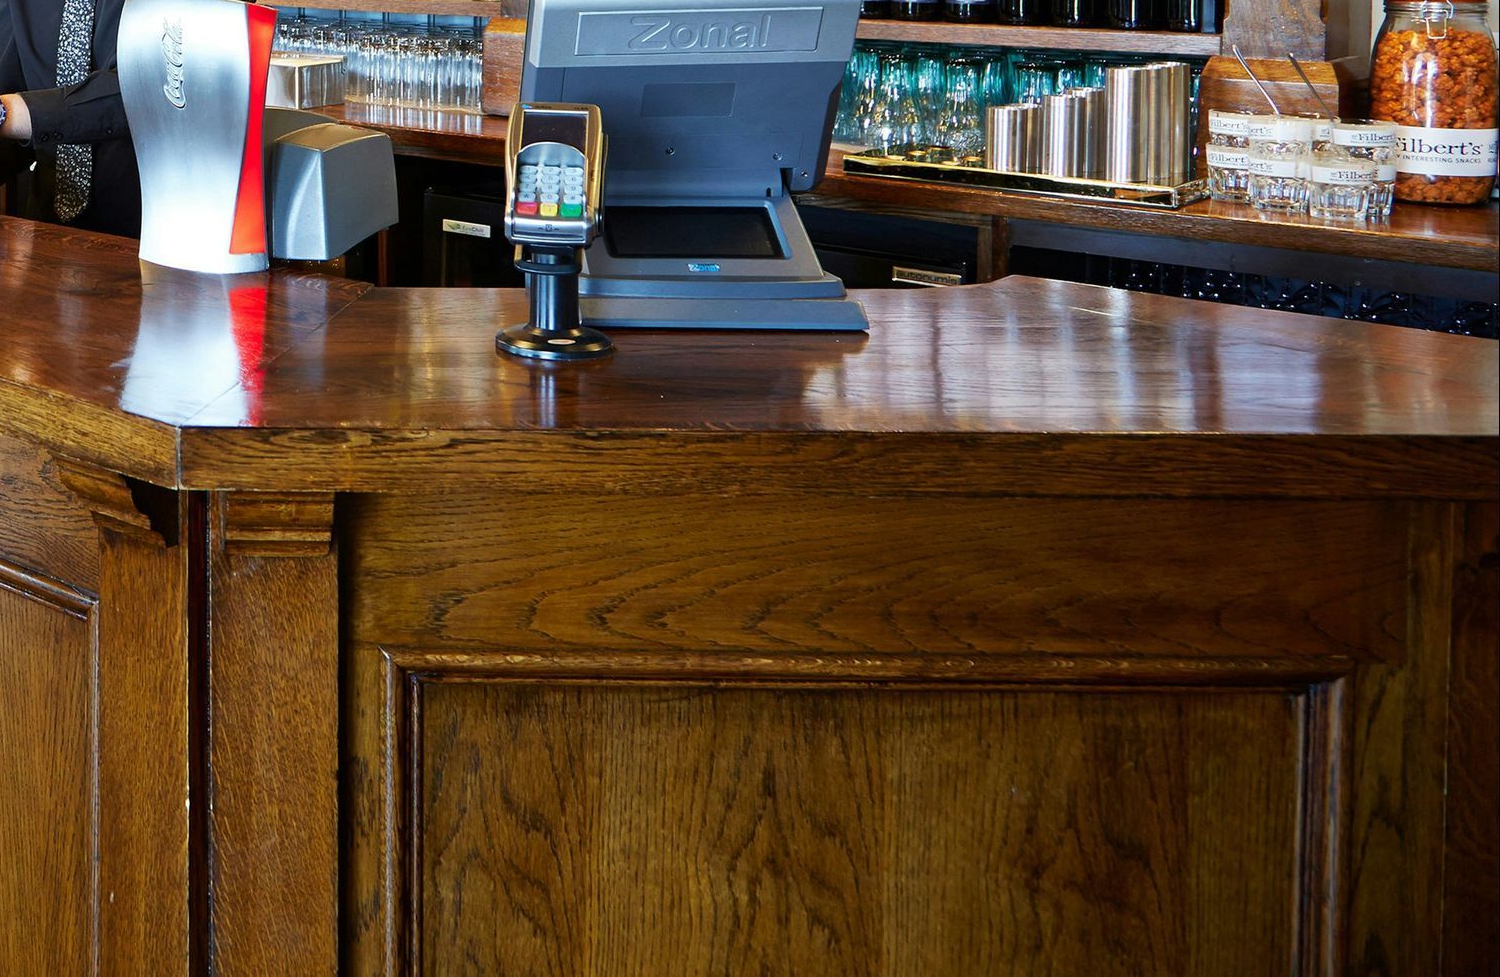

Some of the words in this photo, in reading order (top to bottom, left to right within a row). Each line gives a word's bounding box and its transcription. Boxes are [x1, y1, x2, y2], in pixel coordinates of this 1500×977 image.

[628, 13, 772, 51] Zonal
[161, 14, 187, 109] Coca-Cola
[1395, 137, 1482, 156] ilbert's
[1403, 154, 1454, 163] INTERESTING
